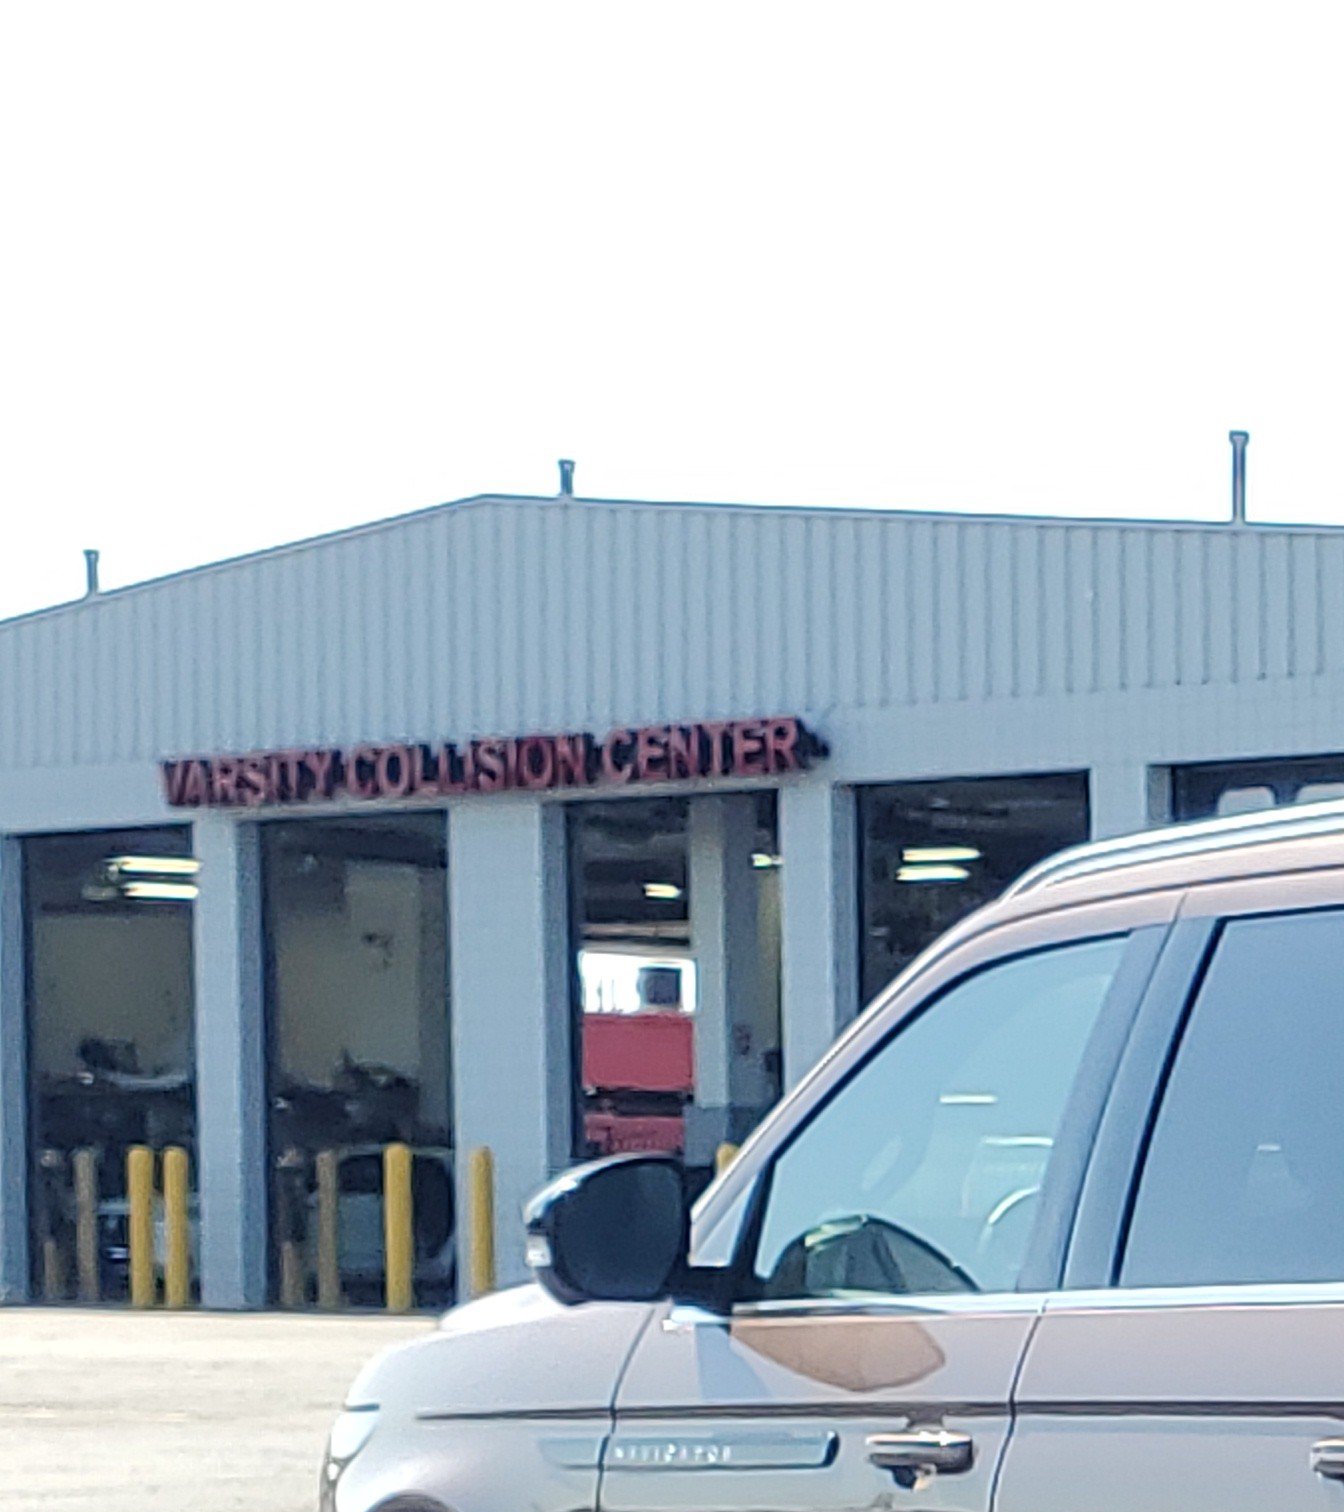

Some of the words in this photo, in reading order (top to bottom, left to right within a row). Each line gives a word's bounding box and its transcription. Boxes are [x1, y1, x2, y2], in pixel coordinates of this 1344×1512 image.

[163, 751, 339, 806] VARSITY
[345, 733, 587, 797] COLLISION
[600, 717, 800, 784] CENTER
